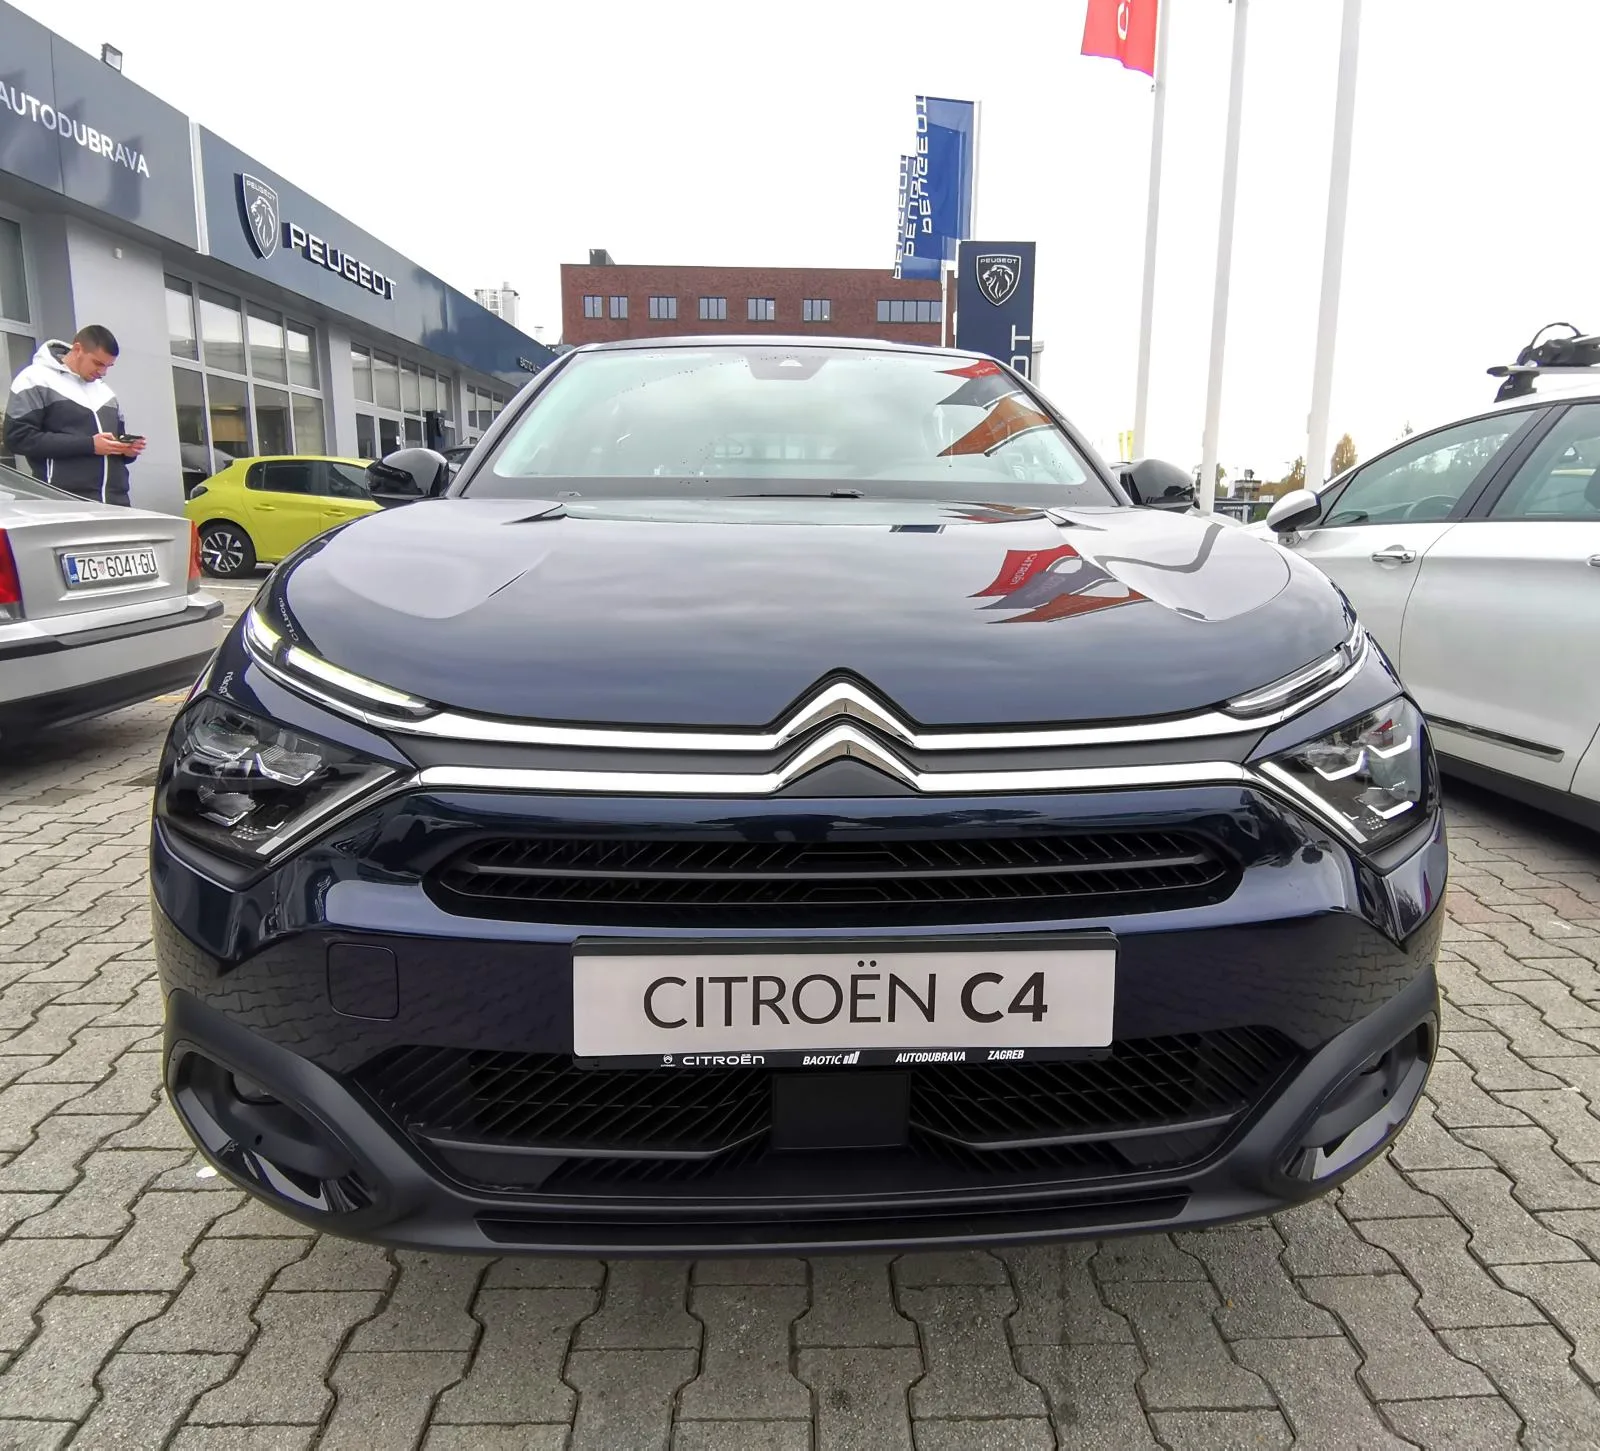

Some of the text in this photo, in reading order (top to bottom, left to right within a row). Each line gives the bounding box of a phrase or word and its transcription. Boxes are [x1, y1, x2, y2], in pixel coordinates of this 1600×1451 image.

[0, 80, 150, 178] AUTODUBRAVA
[246, 180, 276, 200] PEUGEOT
[289, 222, 396, 300] PEUGEOT
[77, 558, 98, 580] ZG
[643, 959, 1048, 1029] CITROËN C4
[802, 1053, 843, 1066] BAOTIĆ
[895, 1051, 966, 1063] AUTODUBRAVA
[987, 1050, 1025, 1061] ZAGREB
